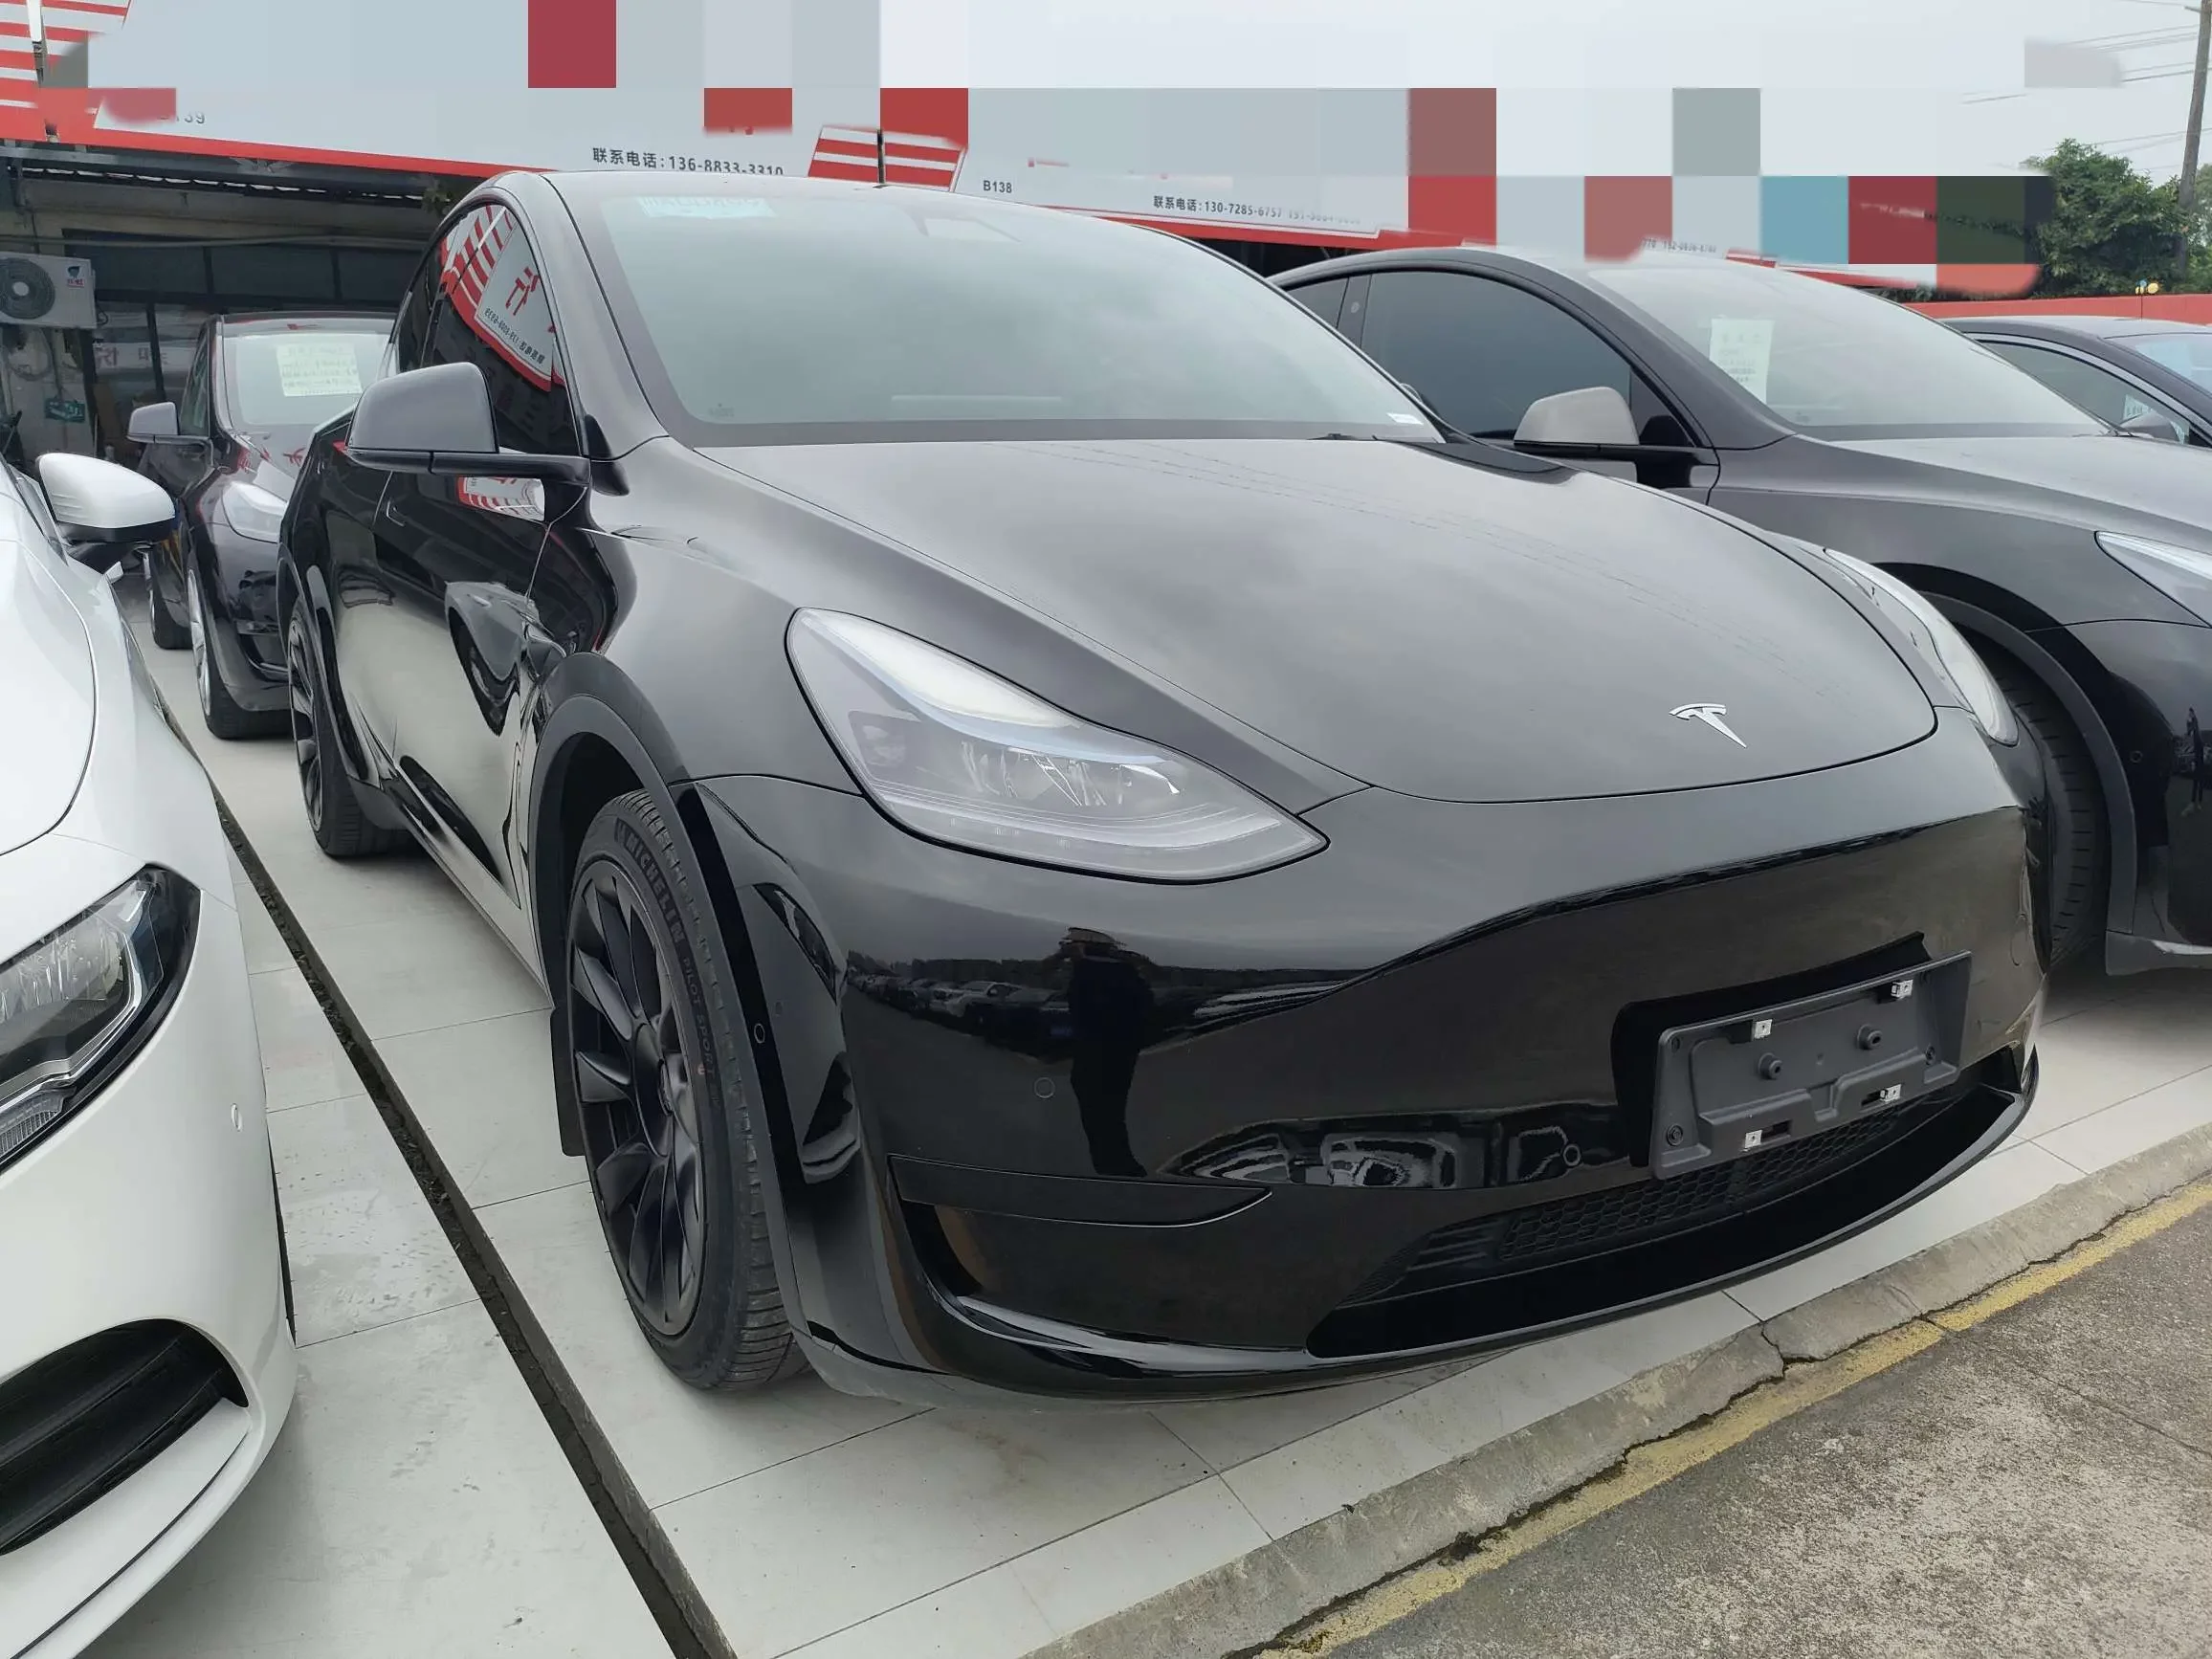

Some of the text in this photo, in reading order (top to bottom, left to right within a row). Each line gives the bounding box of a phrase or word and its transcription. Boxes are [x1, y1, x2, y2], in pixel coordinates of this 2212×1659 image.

[983, 180, 1012, 194] B138
[626, 830, 686, 943] MICHELIN
[682, 956, 702, 1005] PILOT
[696, 1013, 717, 1079] SPORT
